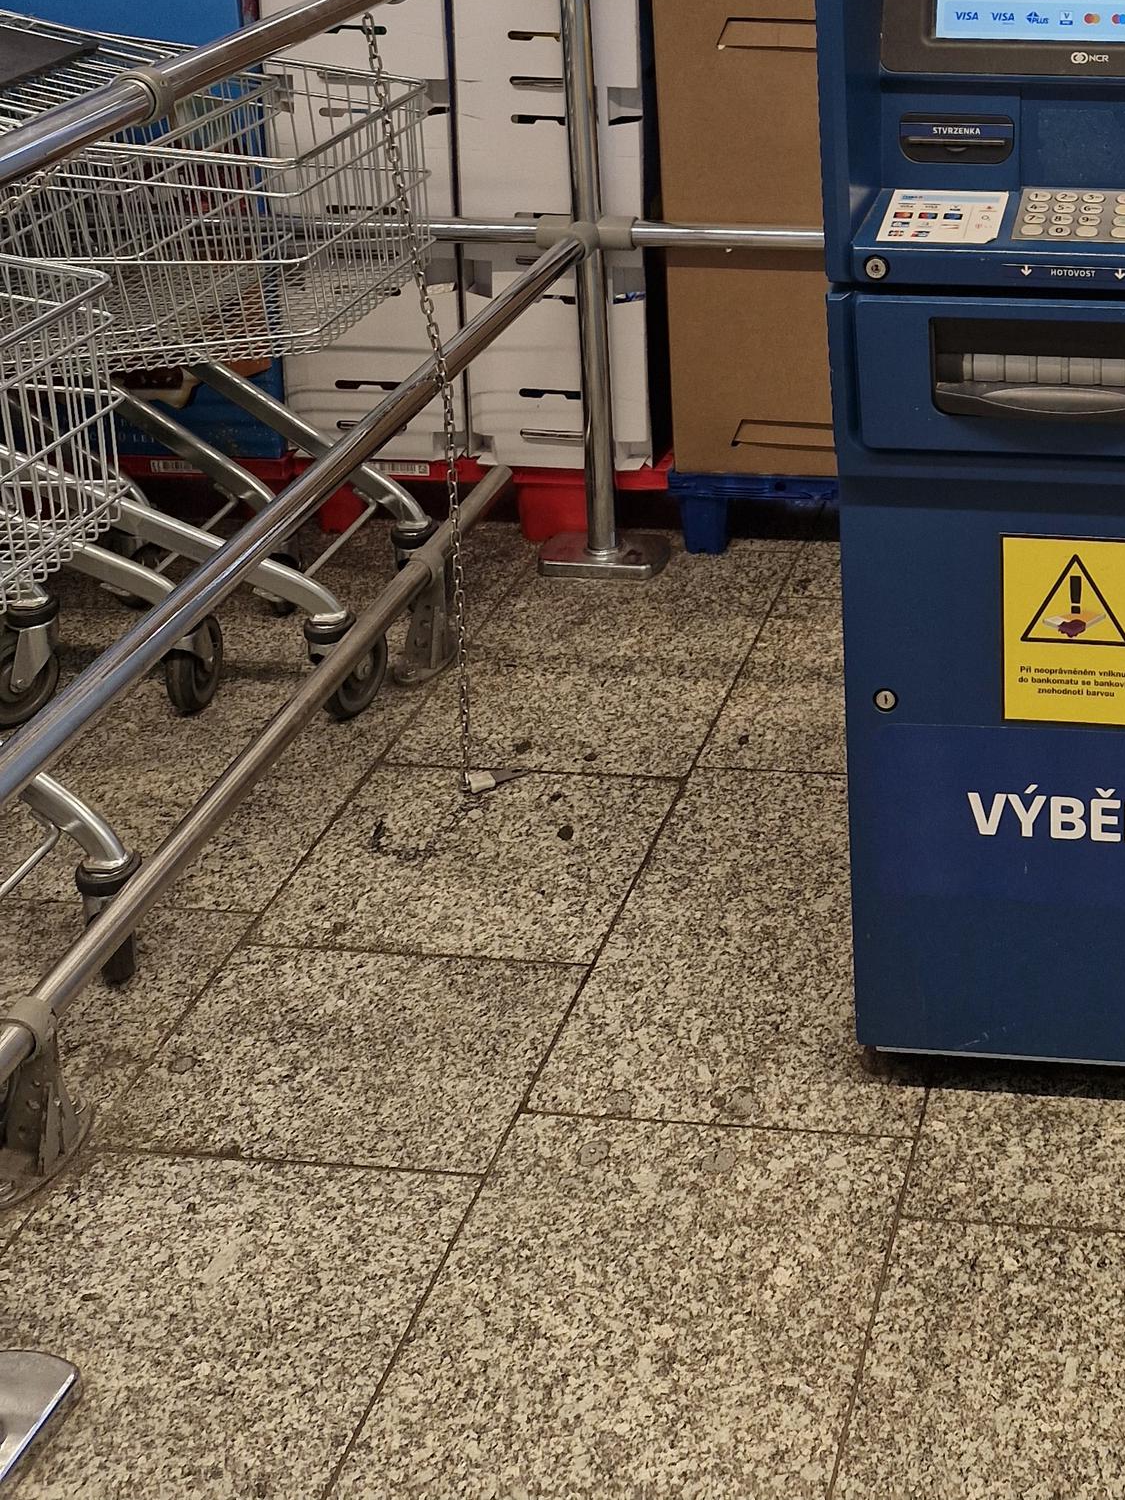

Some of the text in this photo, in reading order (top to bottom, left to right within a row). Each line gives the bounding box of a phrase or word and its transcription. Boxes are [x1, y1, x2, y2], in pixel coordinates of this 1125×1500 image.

[955, 11, 979, 21] VISA
[991, 12, 1015, 21] VISA
[1088, 54, 1109, 62] NCR
[932, 126, 981, 135] STVRZENKA
[1050, 268, 1096, 277] HOTOVOST
[1031, 676, 1079, 685] bankomatu
[1037, 687, 1115, 697] znehodnotí barvou
